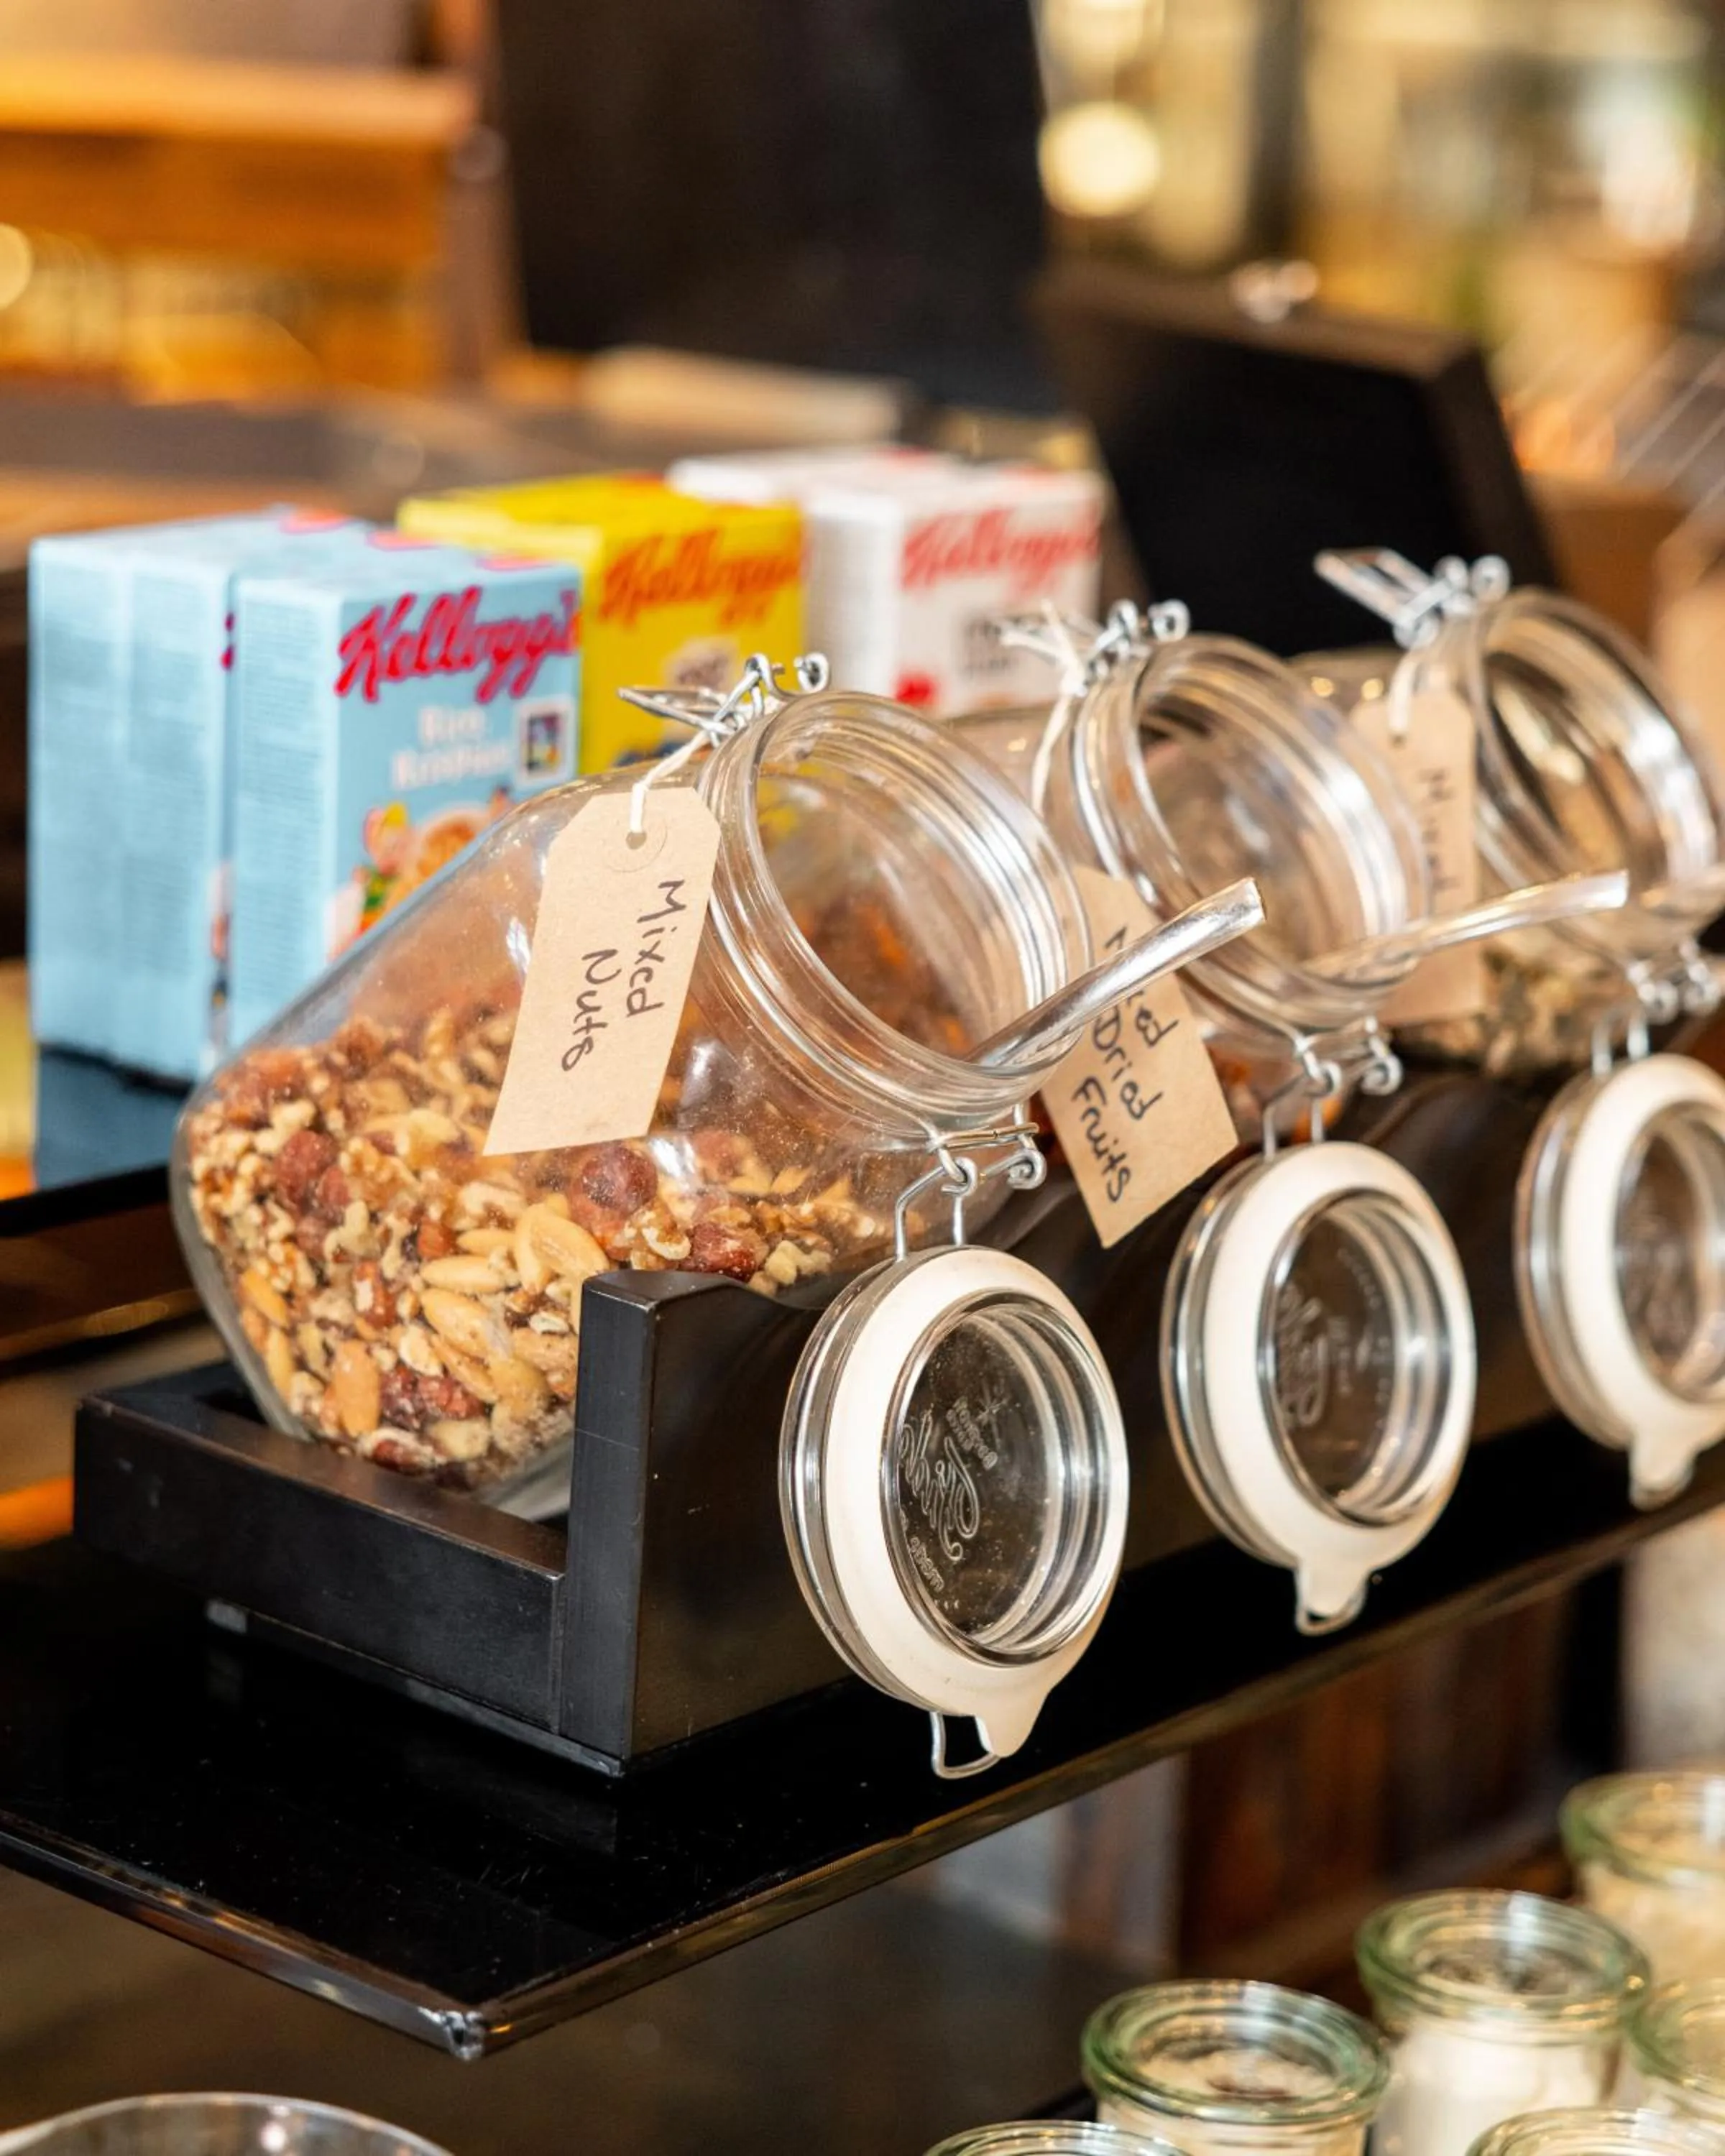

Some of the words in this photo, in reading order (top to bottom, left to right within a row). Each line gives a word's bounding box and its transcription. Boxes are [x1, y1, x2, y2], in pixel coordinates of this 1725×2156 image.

[334, 584, 581, 704] Kellogg's
[626, 879, 687, 1018] Mixed
[561, 949, 623, 1072] Nuts
[1091, 1005, 1164, 1121] Dried
[1072, 1075, 1132, 1203] Fruits
